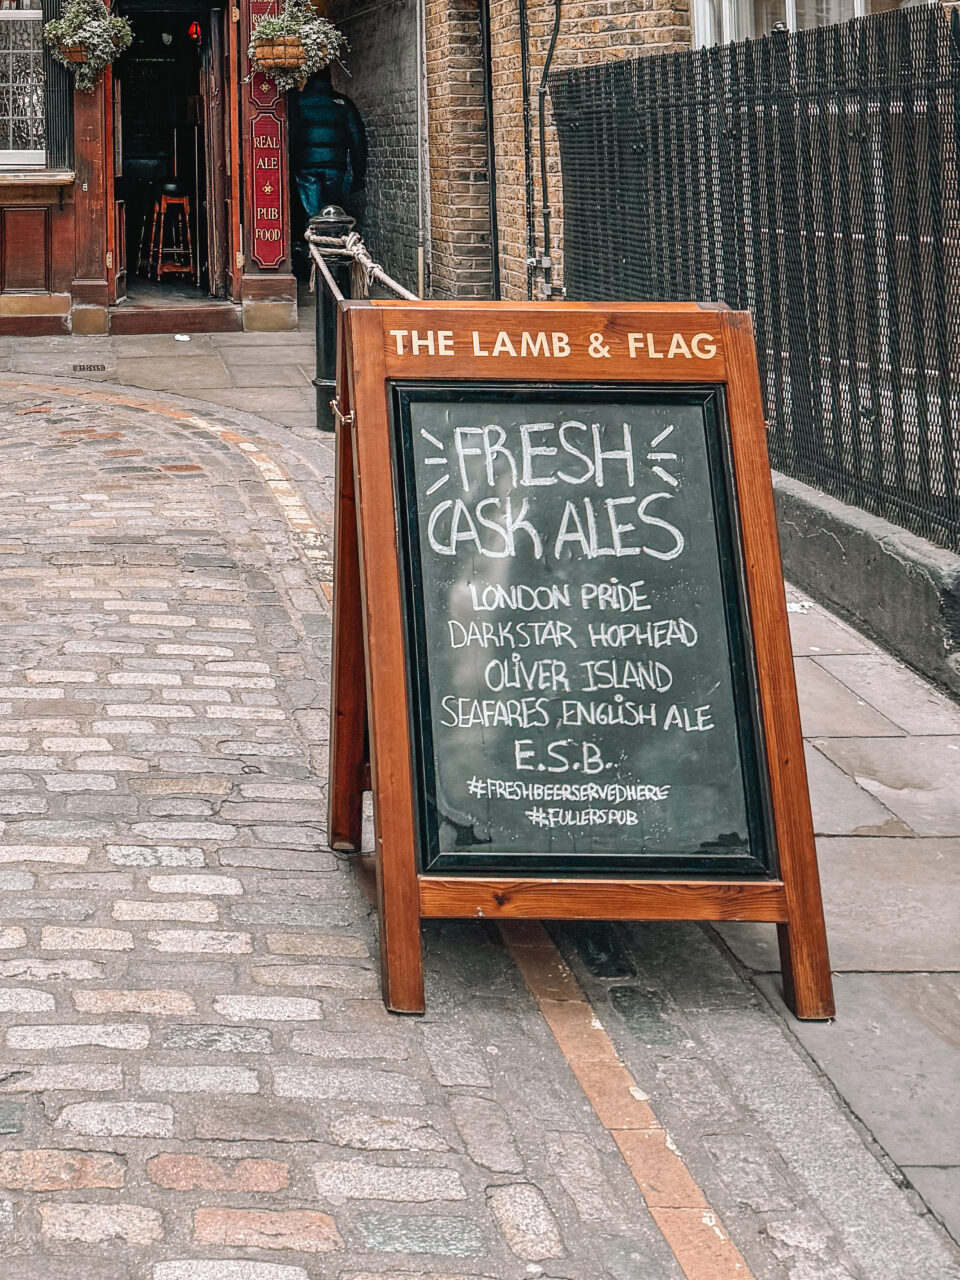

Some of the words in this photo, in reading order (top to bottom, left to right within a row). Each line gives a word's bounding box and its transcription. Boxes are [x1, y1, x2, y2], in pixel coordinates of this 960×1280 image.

[253, 135, 280, 149] REAL
[257, 157, 279, 170] ALE
[257, 207, 279, 220] PUB
[255, 228, 281, 242] FOOD
[389, 330, 455, 357] THE
[472, 331, 571, 358] LAMB
[588, 332, 612, 359] &
[627, 332, 718, 360] FLAG
[454, 420, 635, 491] FRESH
[427, 495, 542, 560] CASK
[555, 492, 685, 561] ALES
[468, 582, 571, 612] LONDON
[448, 620, 578, 649] DARKSTAR
[589, 618, 698, 648] HOPHEAD
[579, 660, 673, 693] ISLAND
[440, 695, 550, 728] SEAFARES
[663, 705, 715, 732] ALE
[467, 776, 671, 804] #FRESHBEERSERVEDHERE
[525, 806, 639, 827] #FULLERSPUB
